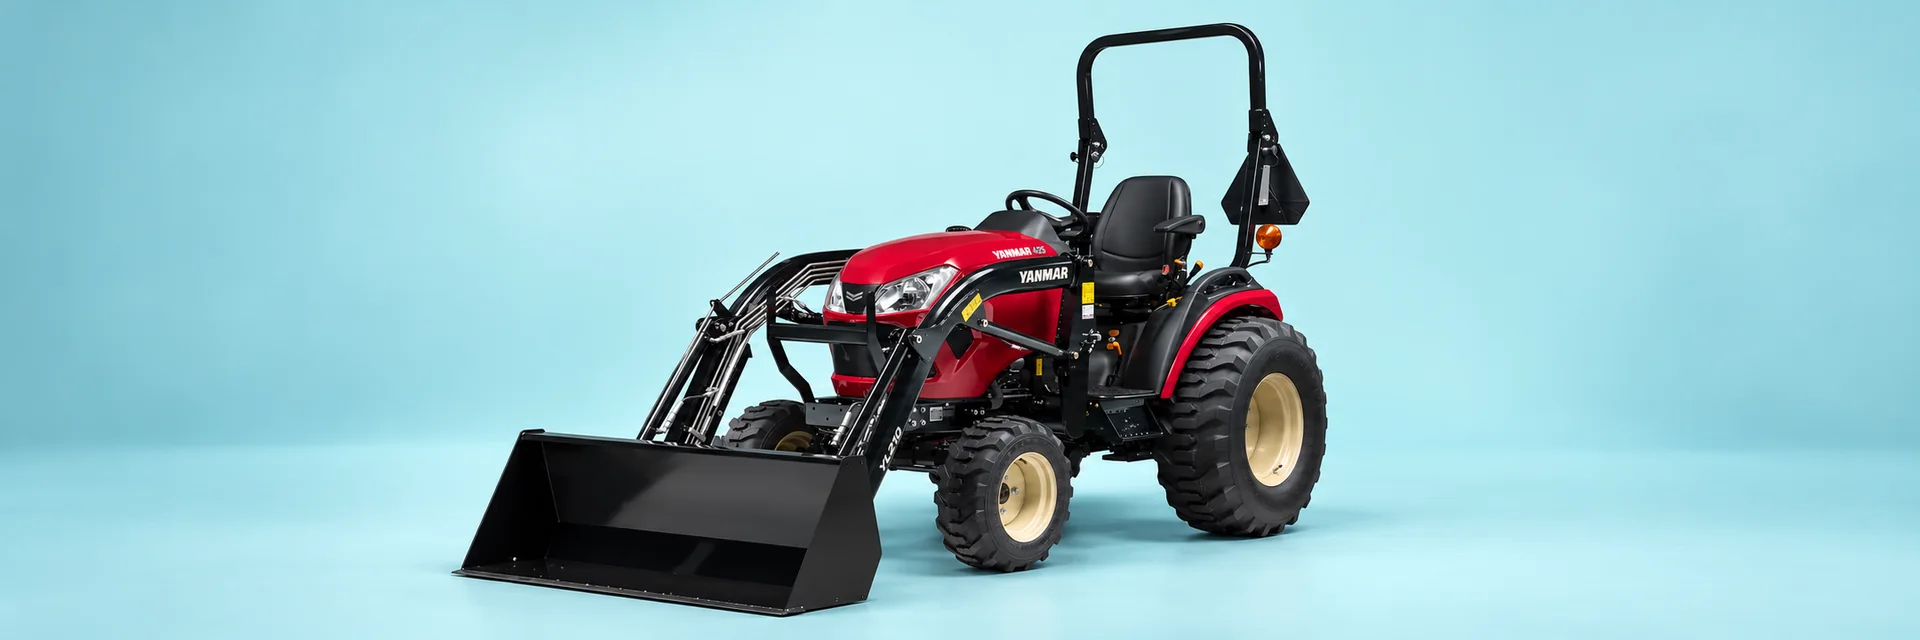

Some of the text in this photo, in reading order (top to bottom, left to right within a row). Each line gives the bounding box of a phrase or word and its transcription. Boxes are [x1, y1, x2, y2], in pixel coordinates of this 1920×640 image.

[992, 246, 1032, 260] YANMAR
[1019, 266, 1068, 284] YANMAR
[879, 426, 902, 471] YL210
